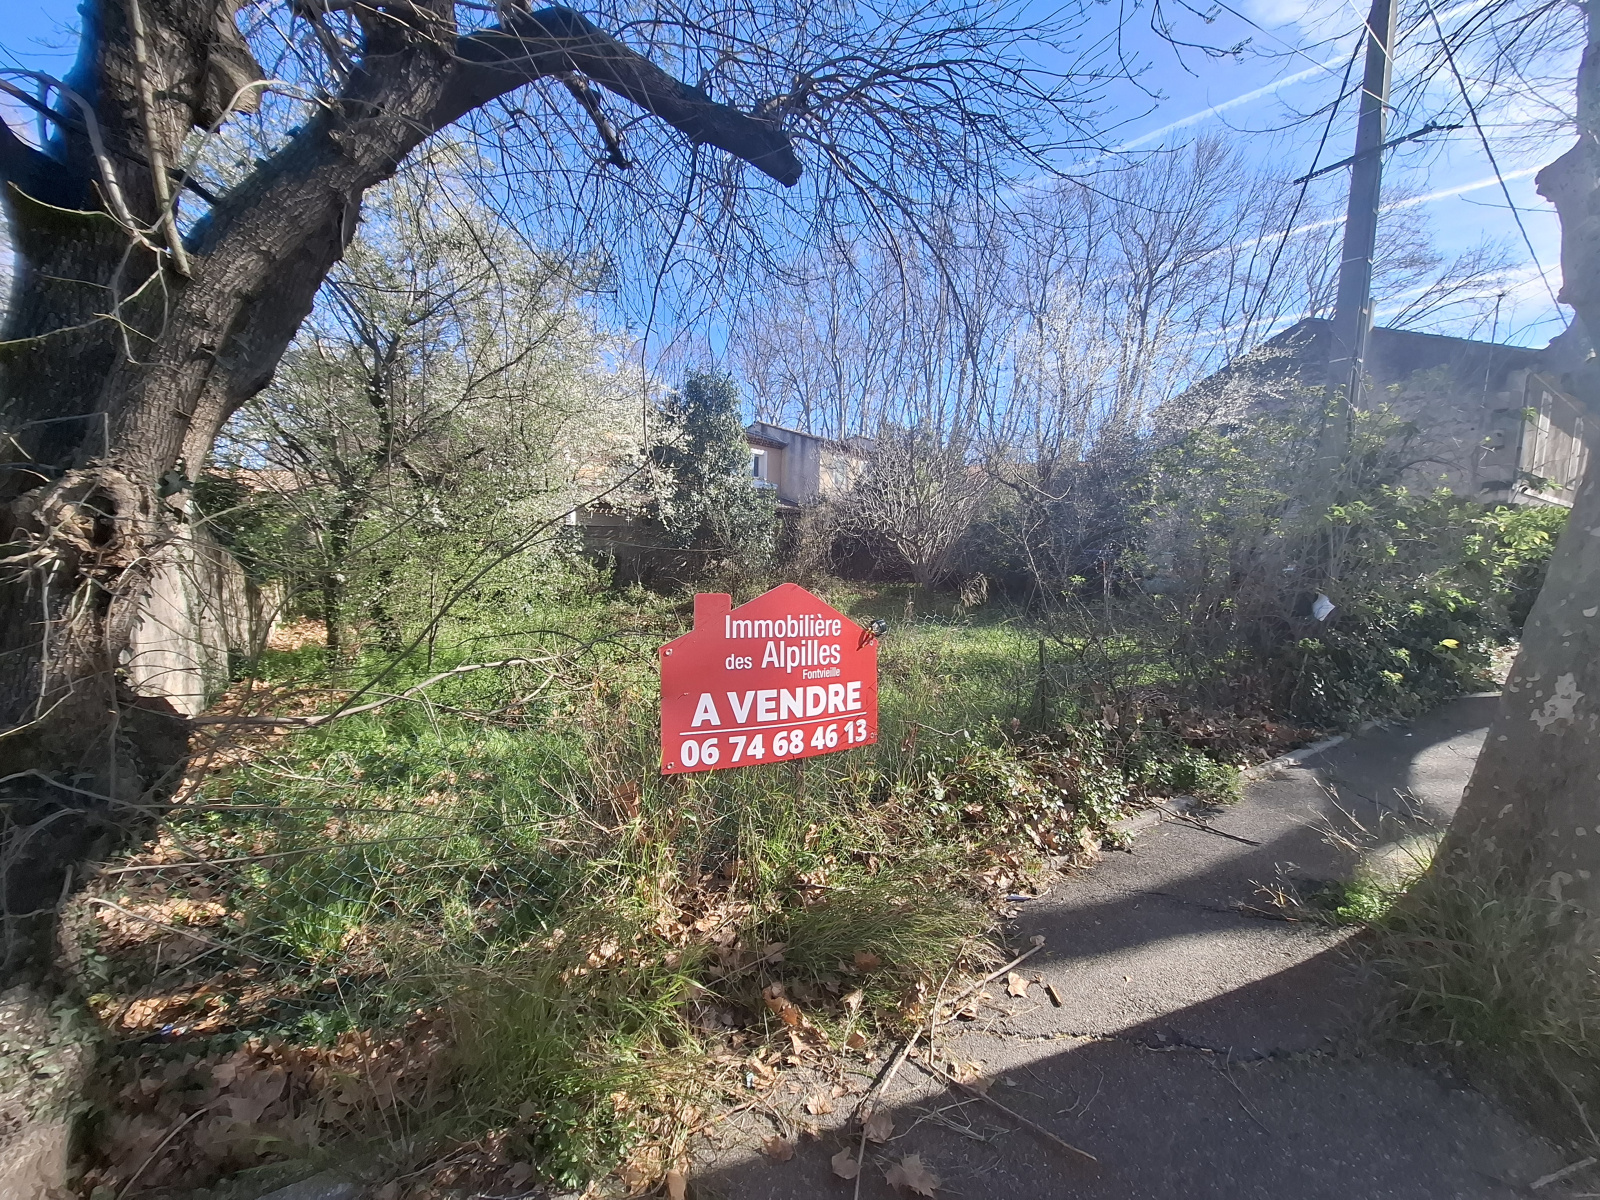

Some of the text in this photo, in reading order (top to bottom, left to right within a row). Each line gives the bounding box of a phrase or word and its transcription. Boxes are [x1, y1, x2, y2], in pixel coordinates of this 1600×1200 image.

[725, 613, 841, 639] Immobilière
[725, 640, 840, 673] des Alpilles
[803, 668, 840, 679] Fontvieille
[691, 681, 861, 727] A VENDRE
[680, 720, 867, 767] 06 74 68 46 13
